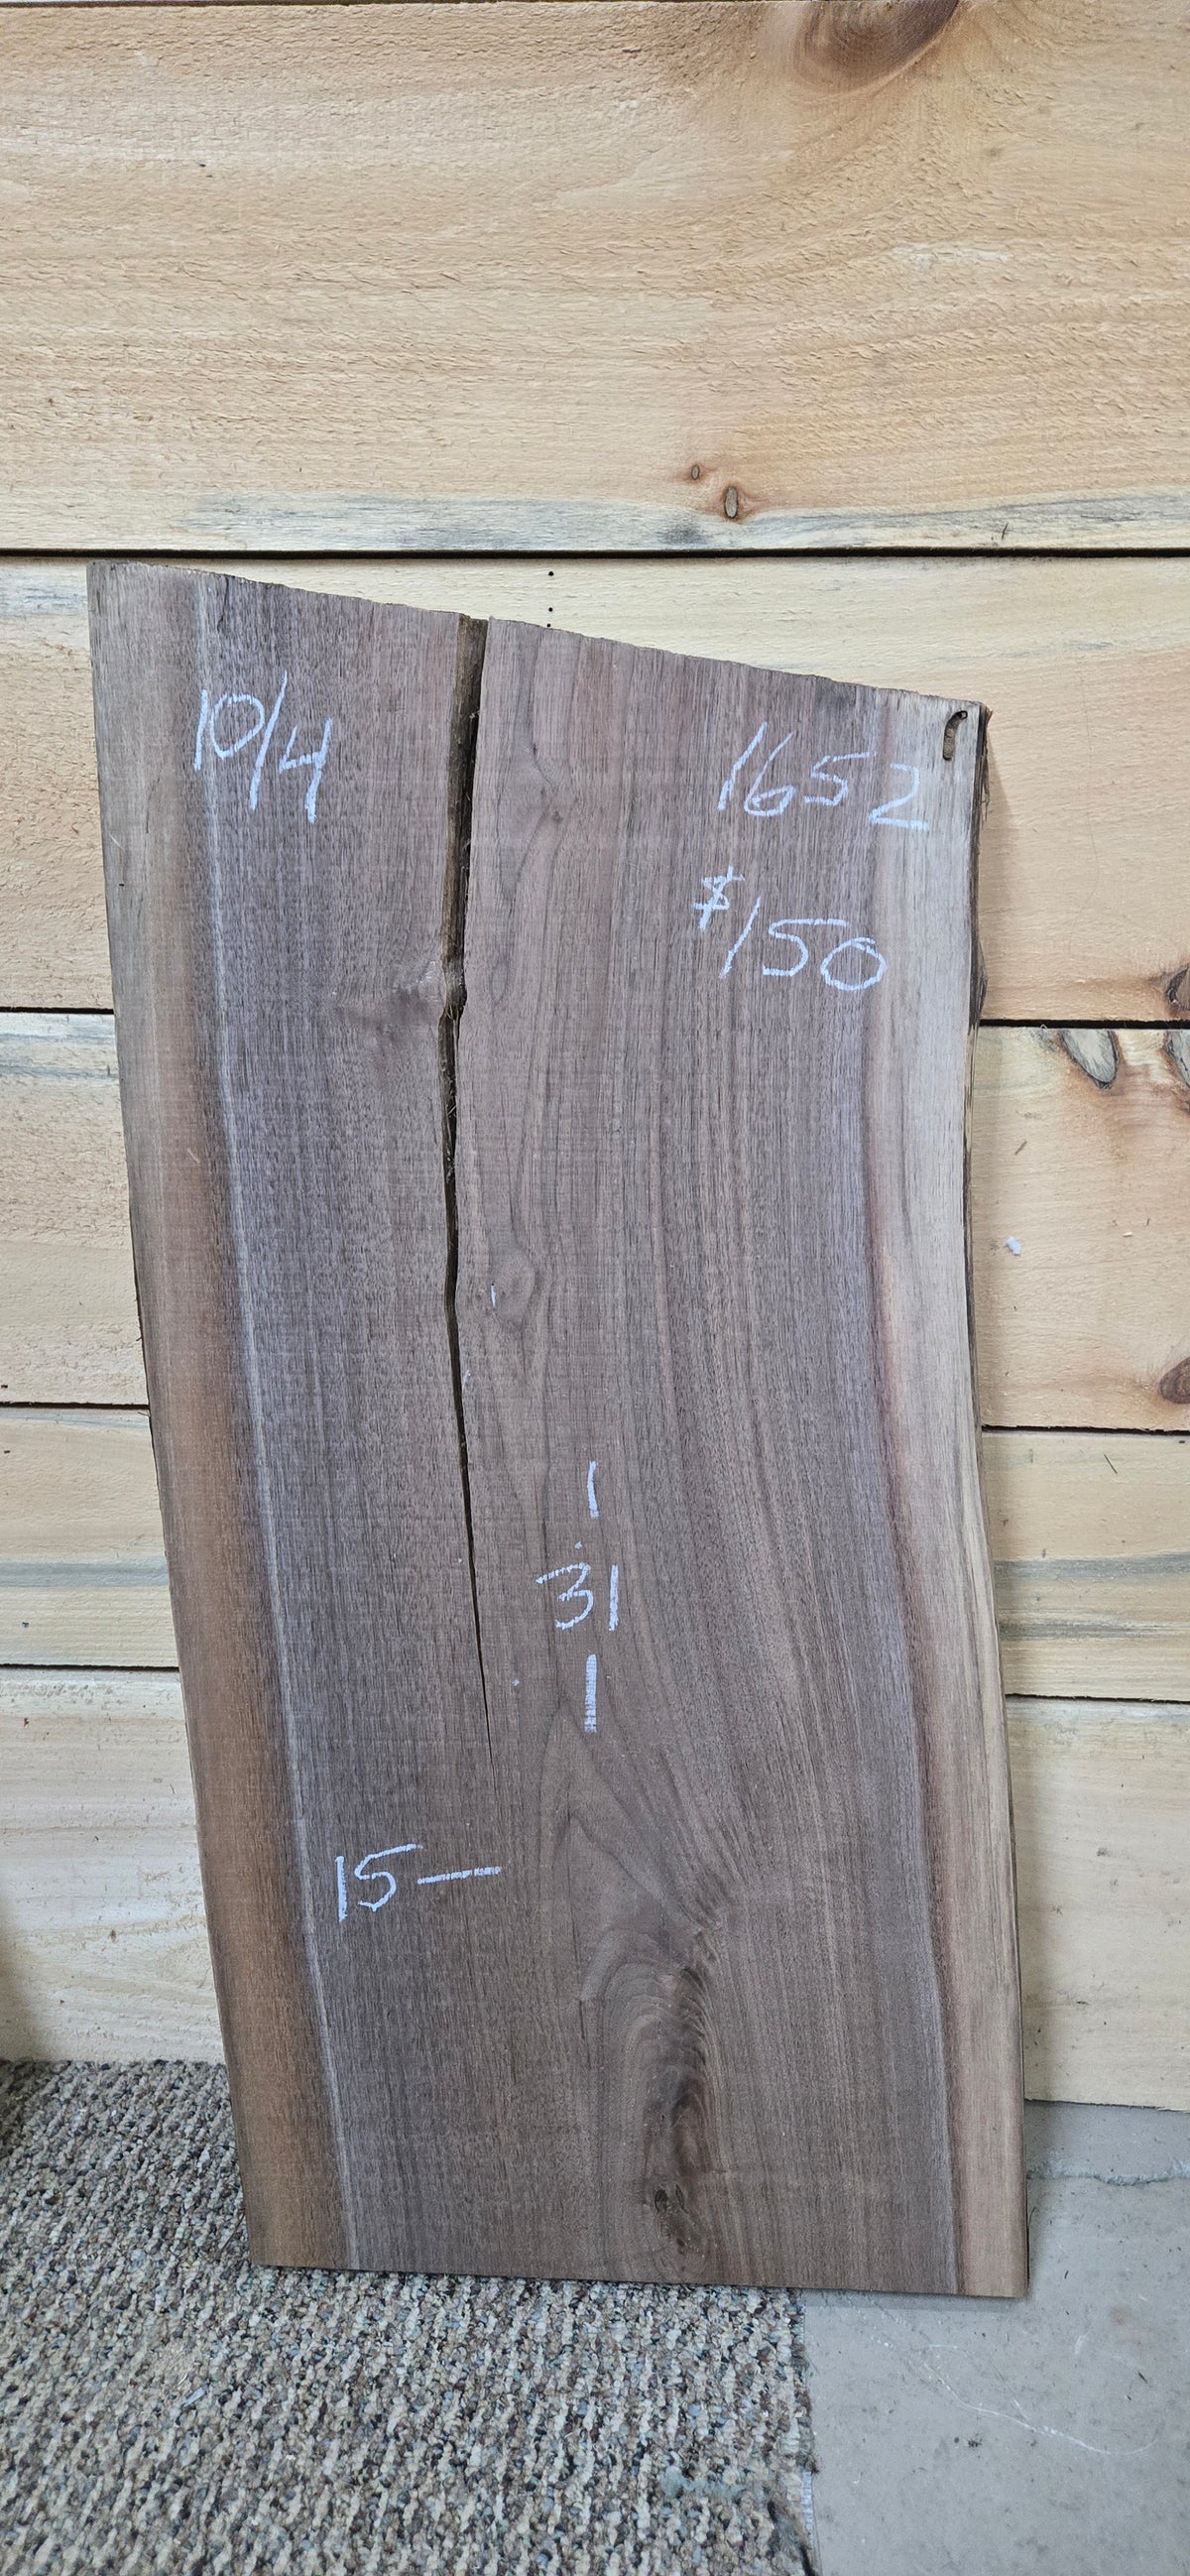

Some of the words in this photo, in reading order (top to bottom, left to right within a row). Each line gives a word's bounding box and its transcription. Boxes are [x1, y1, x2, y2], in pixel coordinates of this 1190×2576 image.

[193, 671, 332, 824] 10/4
[717, 721, 930, 831] 1652
[693, 865, 887, 991] $150
[536, 1562, 620, 1632] 31
